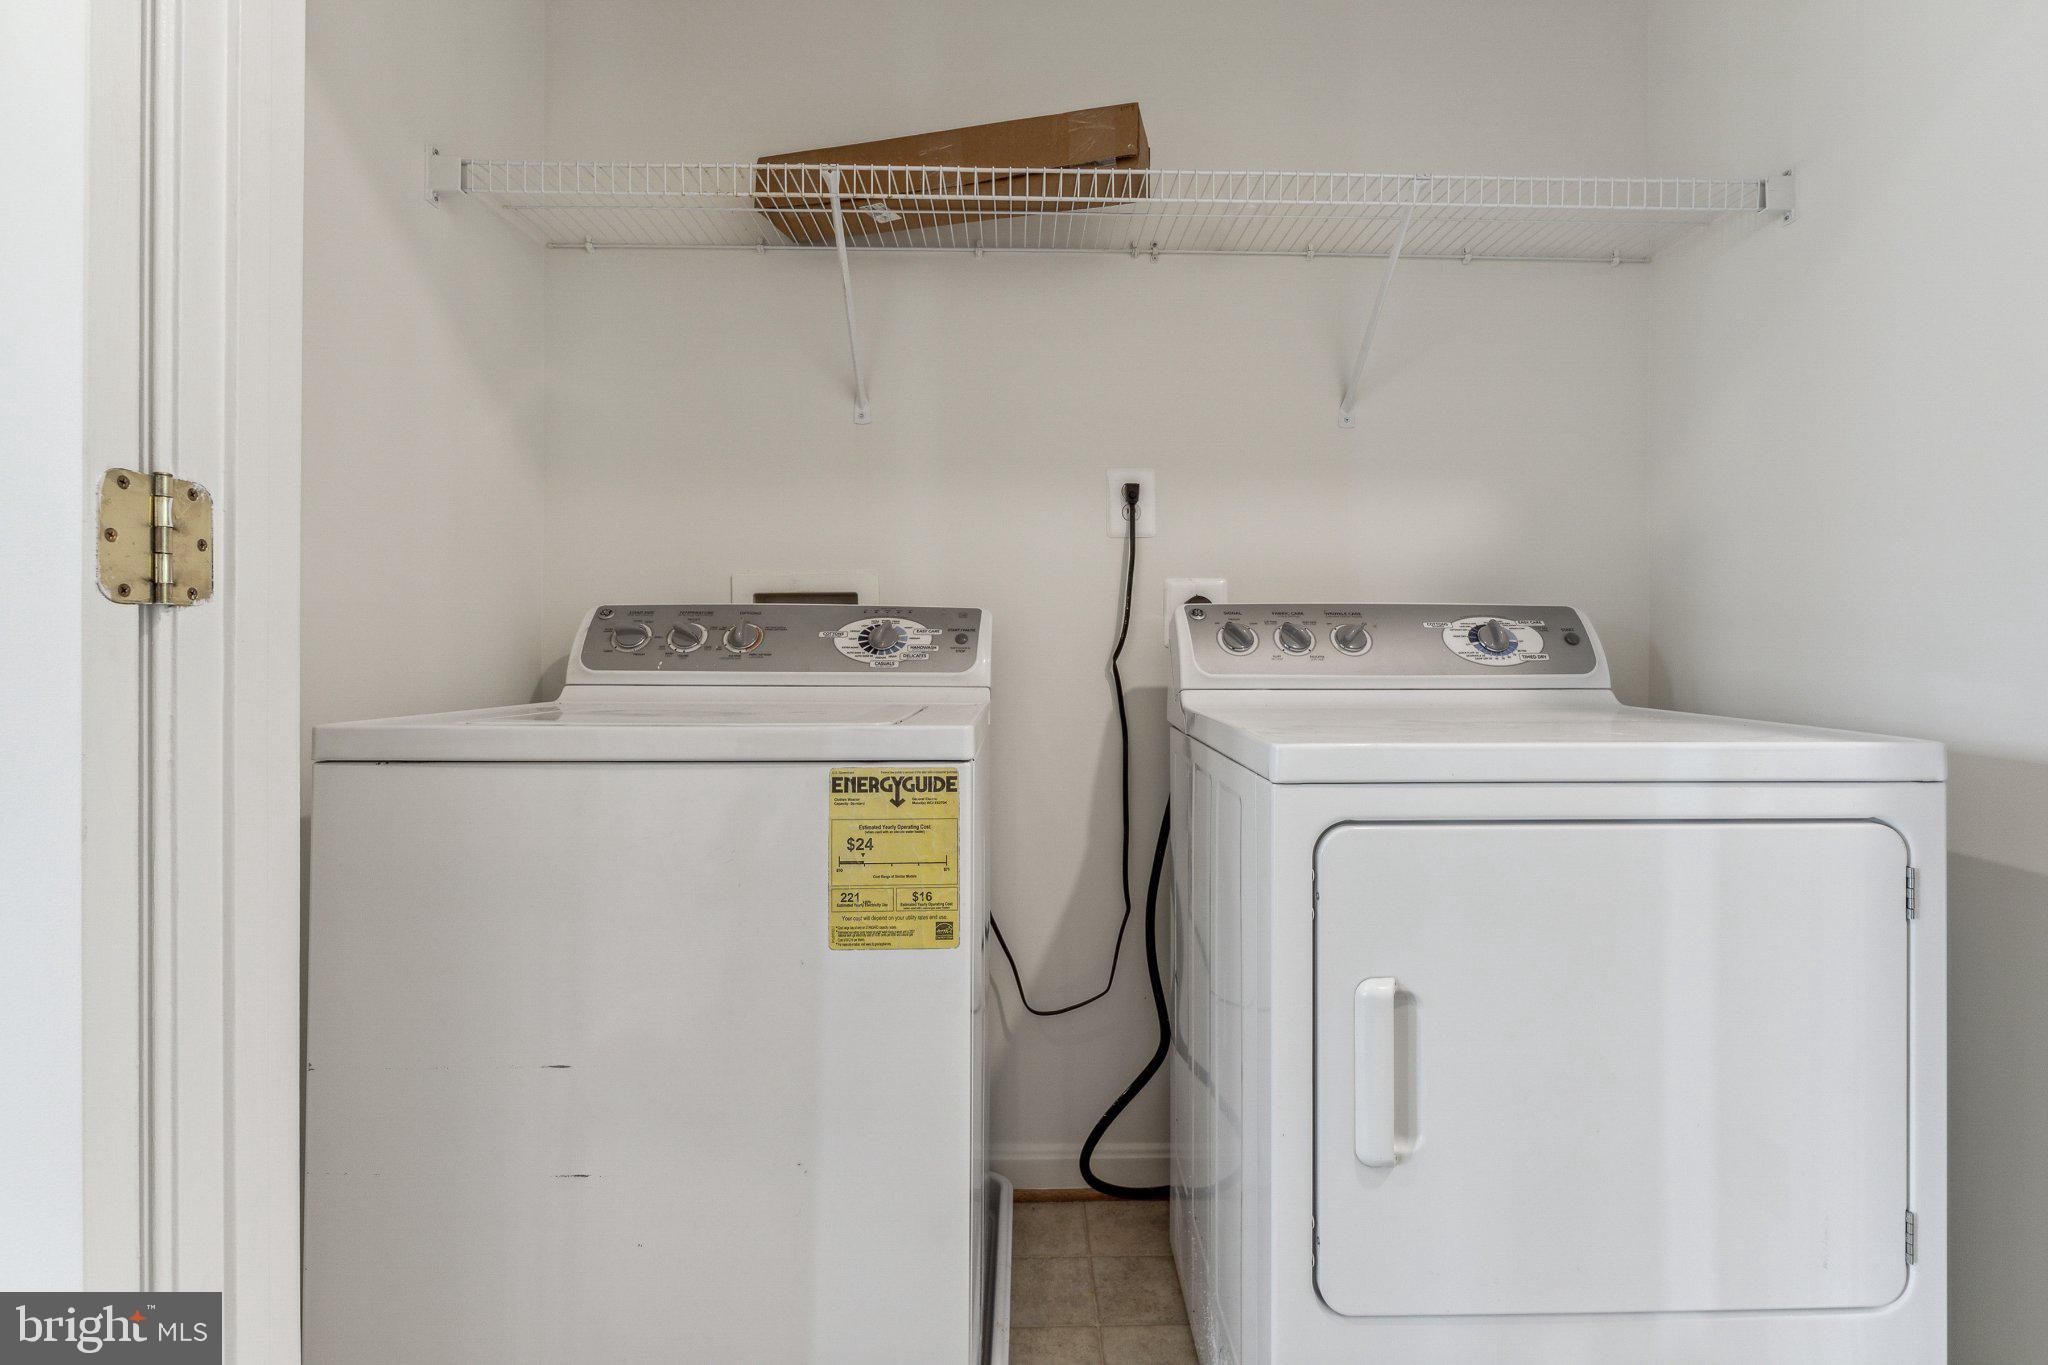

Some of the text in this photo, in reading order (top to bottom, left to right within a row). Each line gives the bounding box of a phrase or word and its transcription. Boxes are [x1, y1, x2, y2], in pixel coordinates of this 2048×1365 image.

[831, 775, 958, 803] ENERGYGUIDE
[846, 836, 874, 852] $24
[840, 892, 860, 903] 221
[912, 891, 933, 903] $16
